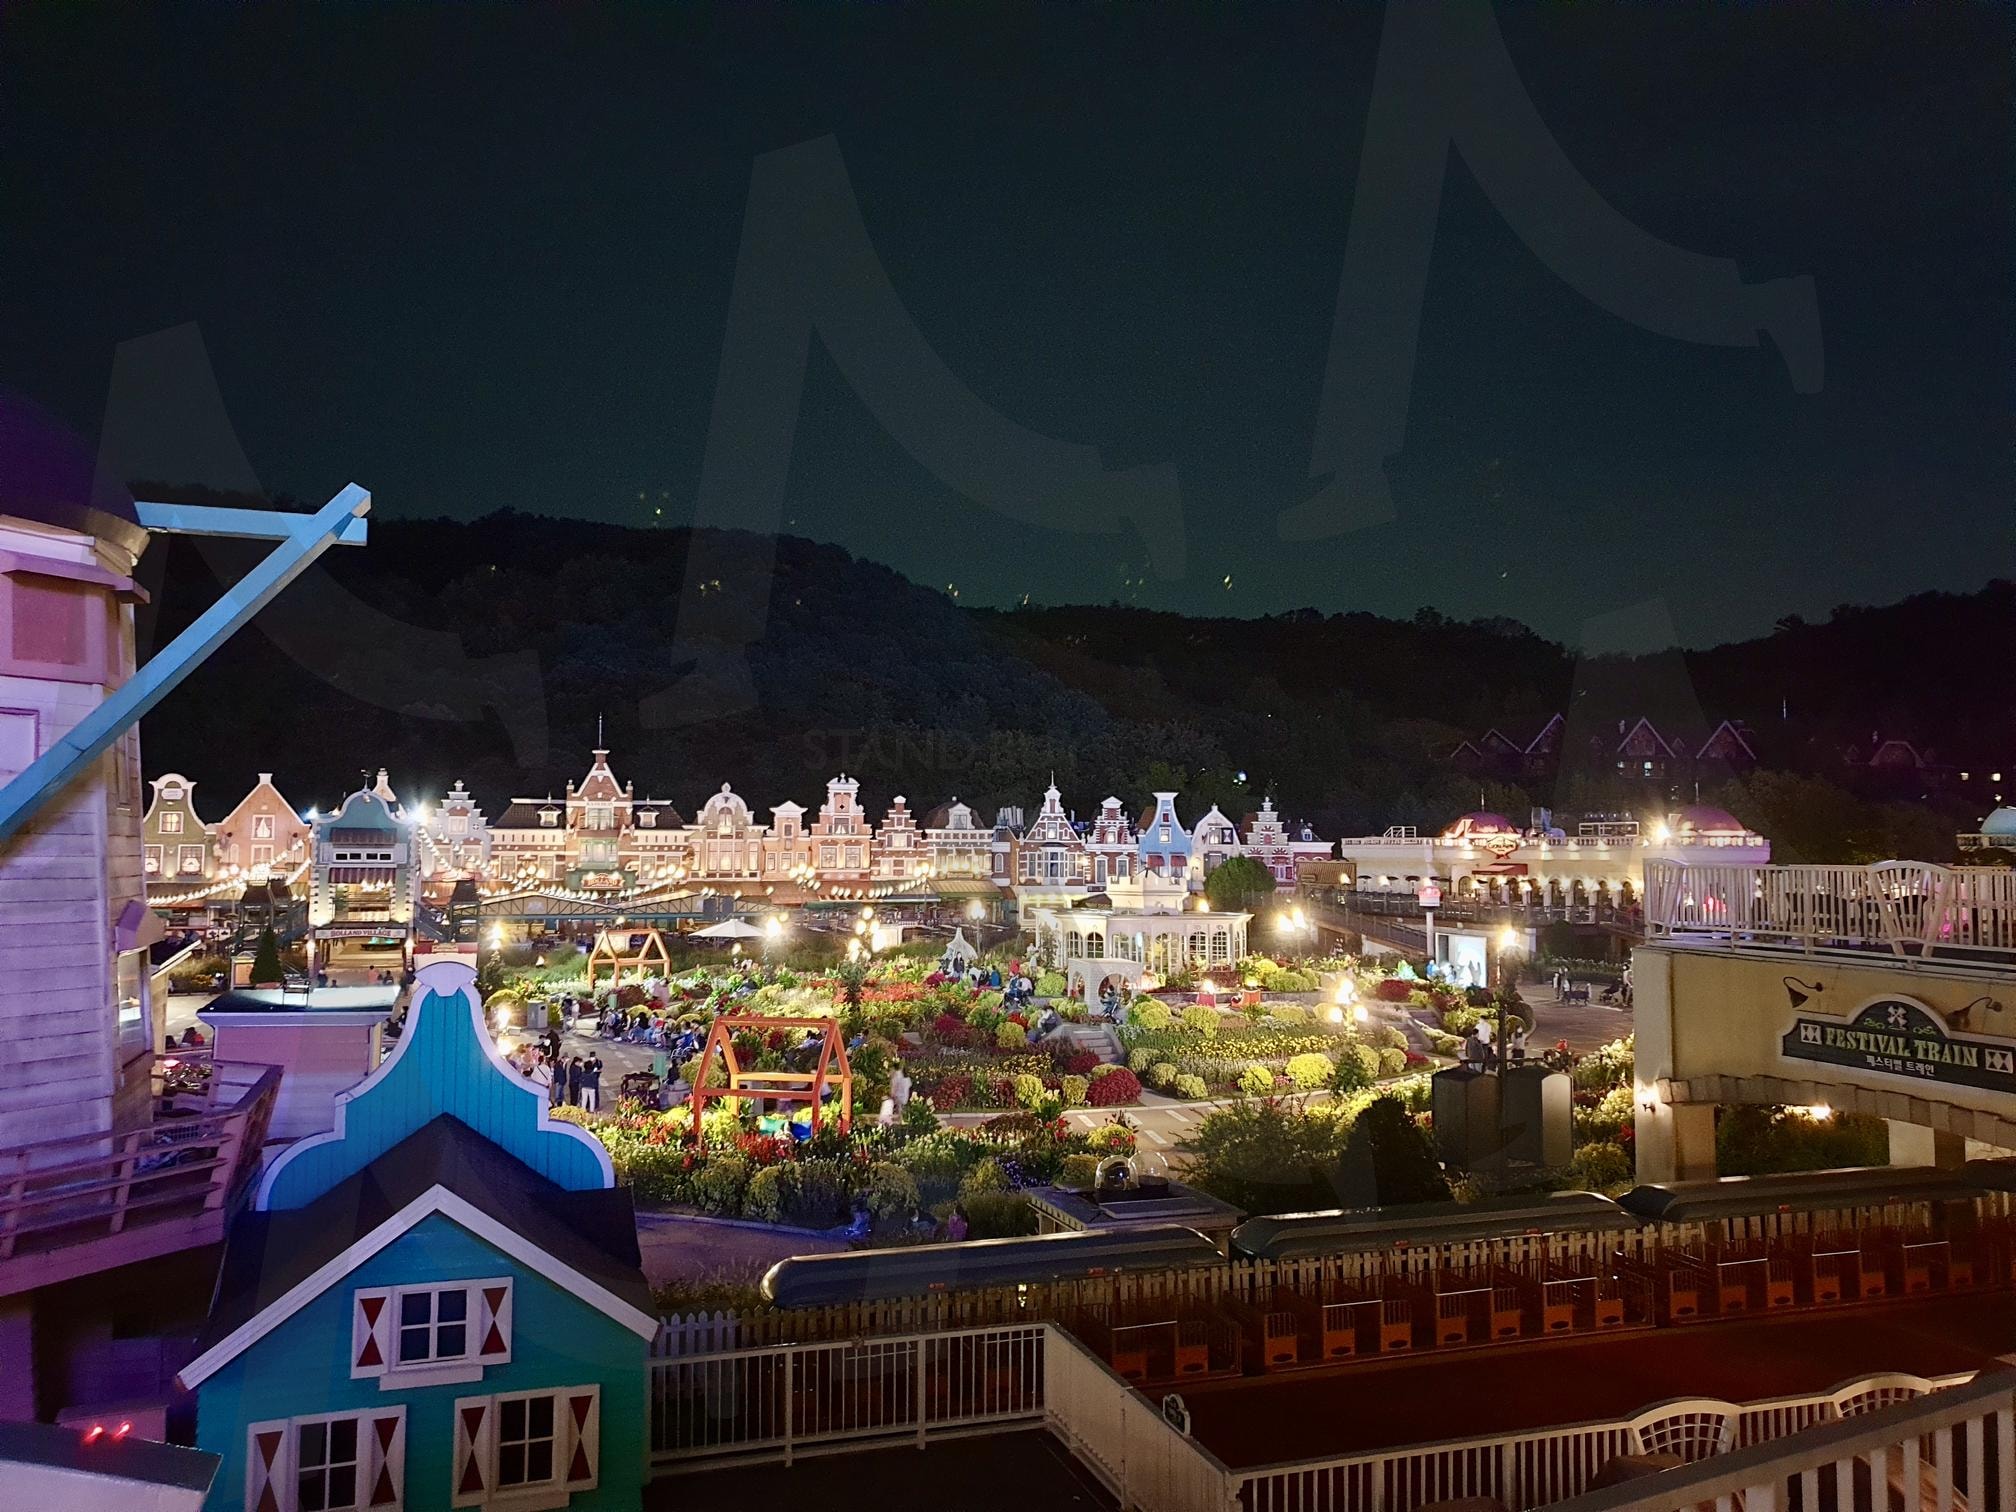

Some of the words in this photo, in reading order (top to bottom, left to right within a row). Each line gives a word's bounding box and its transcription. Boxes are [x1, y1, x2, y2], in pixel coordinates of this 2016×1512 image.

[1826, 1028, 1911, 1057] FESTIVAL
[1914, 1040, 1978, 1067] TRAIN
[1905, 1062, 1936, 1076] 트레인
